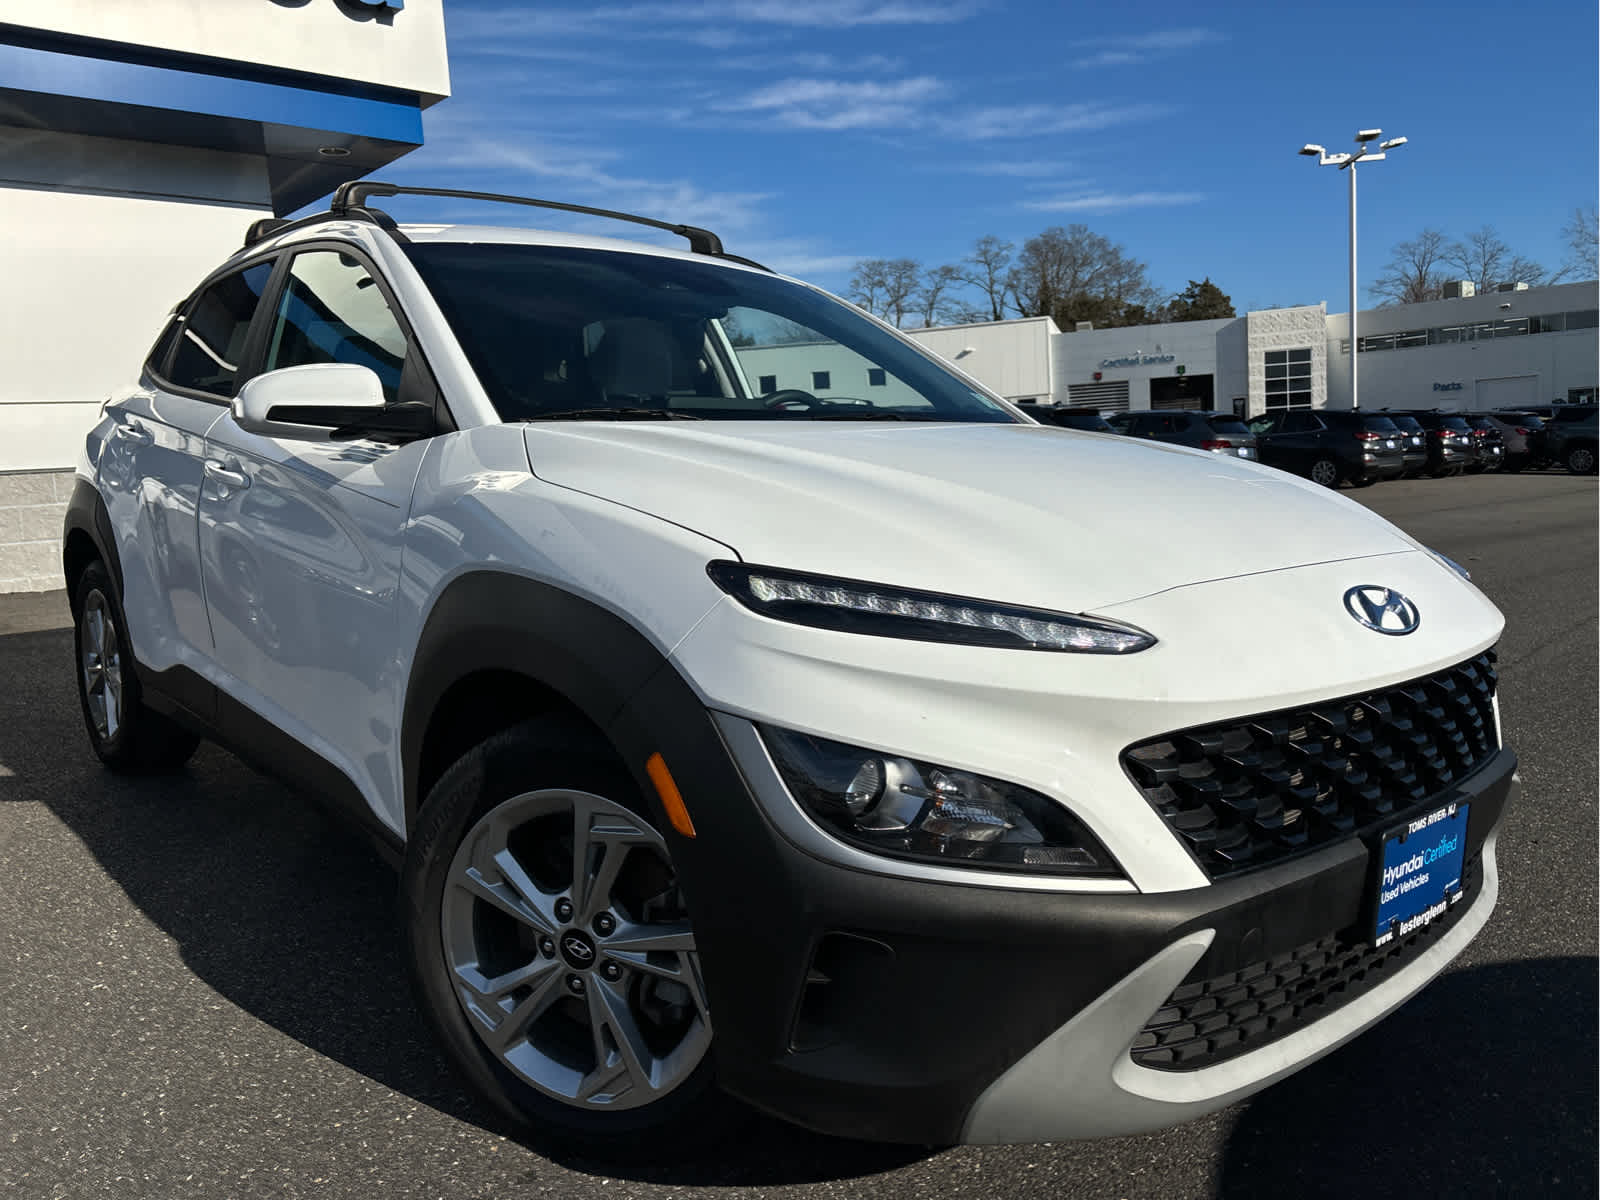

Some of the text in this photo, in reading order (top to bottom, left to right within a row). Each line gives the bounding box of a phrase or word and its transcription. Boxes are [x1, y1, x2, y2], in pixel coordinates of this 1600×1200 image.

[1432, 382, 1463, 391] Parts
[1408, 817, 1427, 835] TOMS
[1447, 802, 1456, 816] NJ
[1383, 833, 1458, 886] Hyundai Certified
[1381, 883, 1400, 905] Used
[1400, 872, 1430, 894] Vehicles
[1399, 900, 1447, 936] lesterglenn
